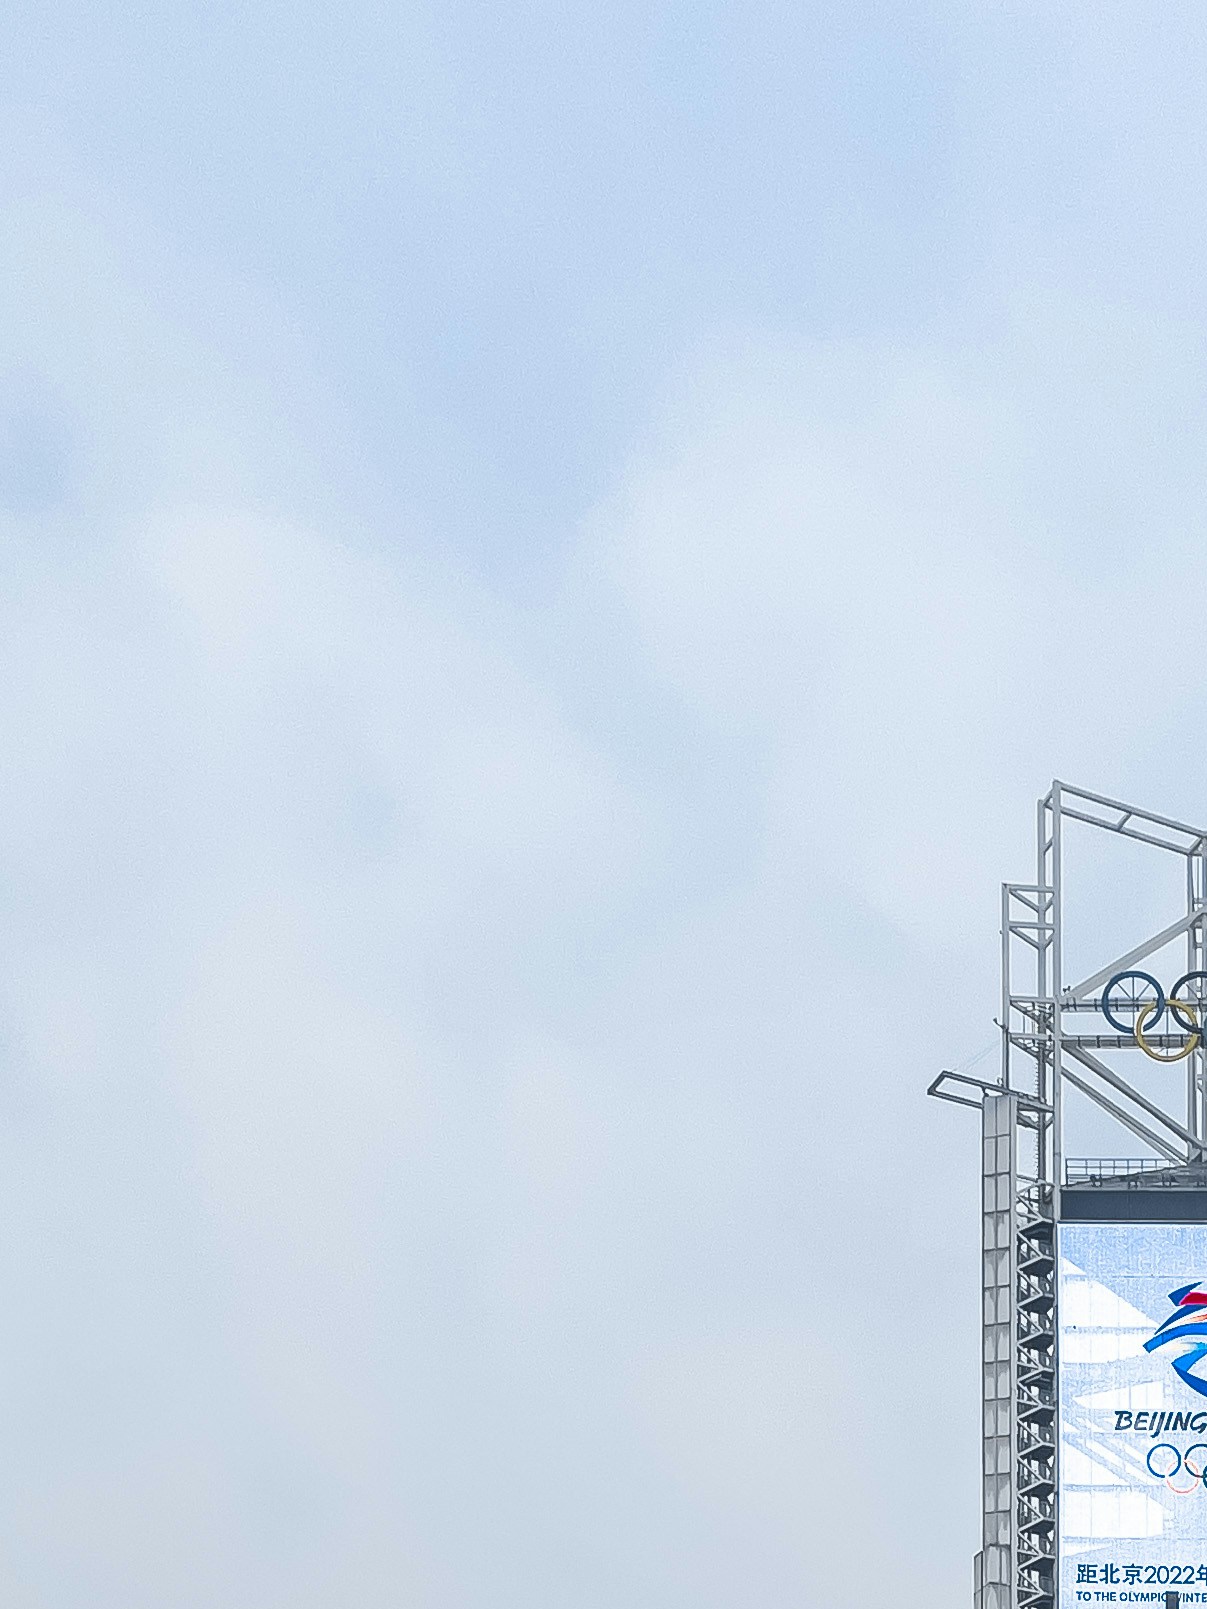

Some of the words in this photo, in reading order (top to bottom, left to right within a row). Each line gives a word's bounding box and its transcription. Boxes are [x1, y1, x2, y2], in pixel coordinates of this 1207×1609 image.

[1115, 1411, 1207, 1438] BEIJING
[1076, 1590, 1092, 1602] TO
[1094, 1591, 1117, 1602] THE
